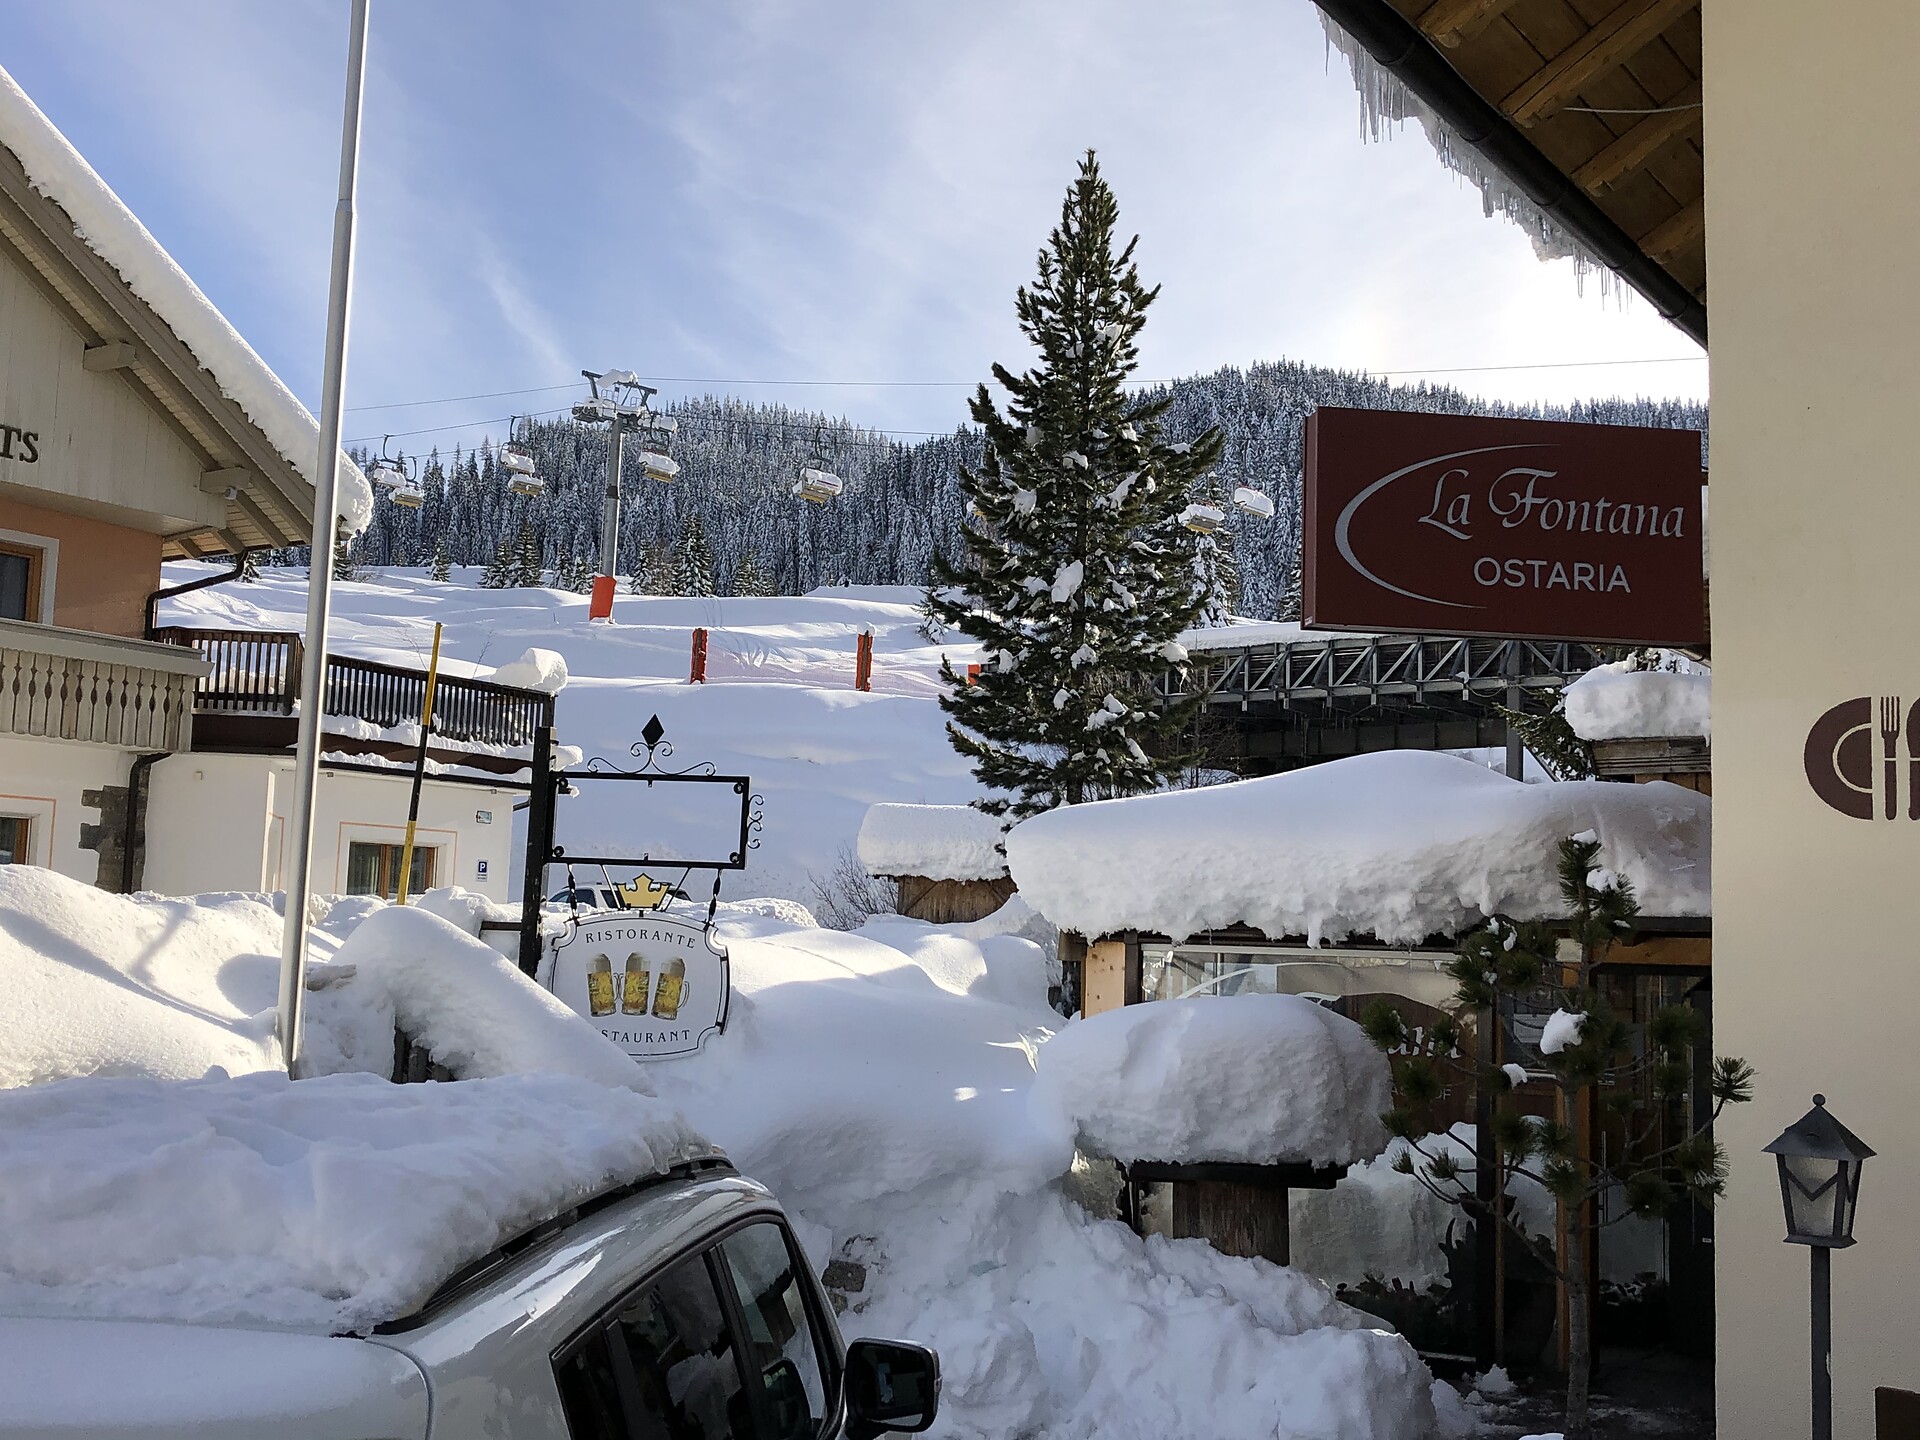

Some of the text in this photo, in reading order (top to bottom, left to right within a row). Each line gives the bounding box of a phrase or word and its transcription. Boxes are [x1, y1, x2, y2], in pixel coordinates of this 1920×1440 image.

[1418, 467, 1685, 541] La Fontana
[1473, 556, 1632, 593] OSTARIA
[585, 928, 697, 949] RISTORANTE
[596, 1028, 691, 1043] STAURANT
